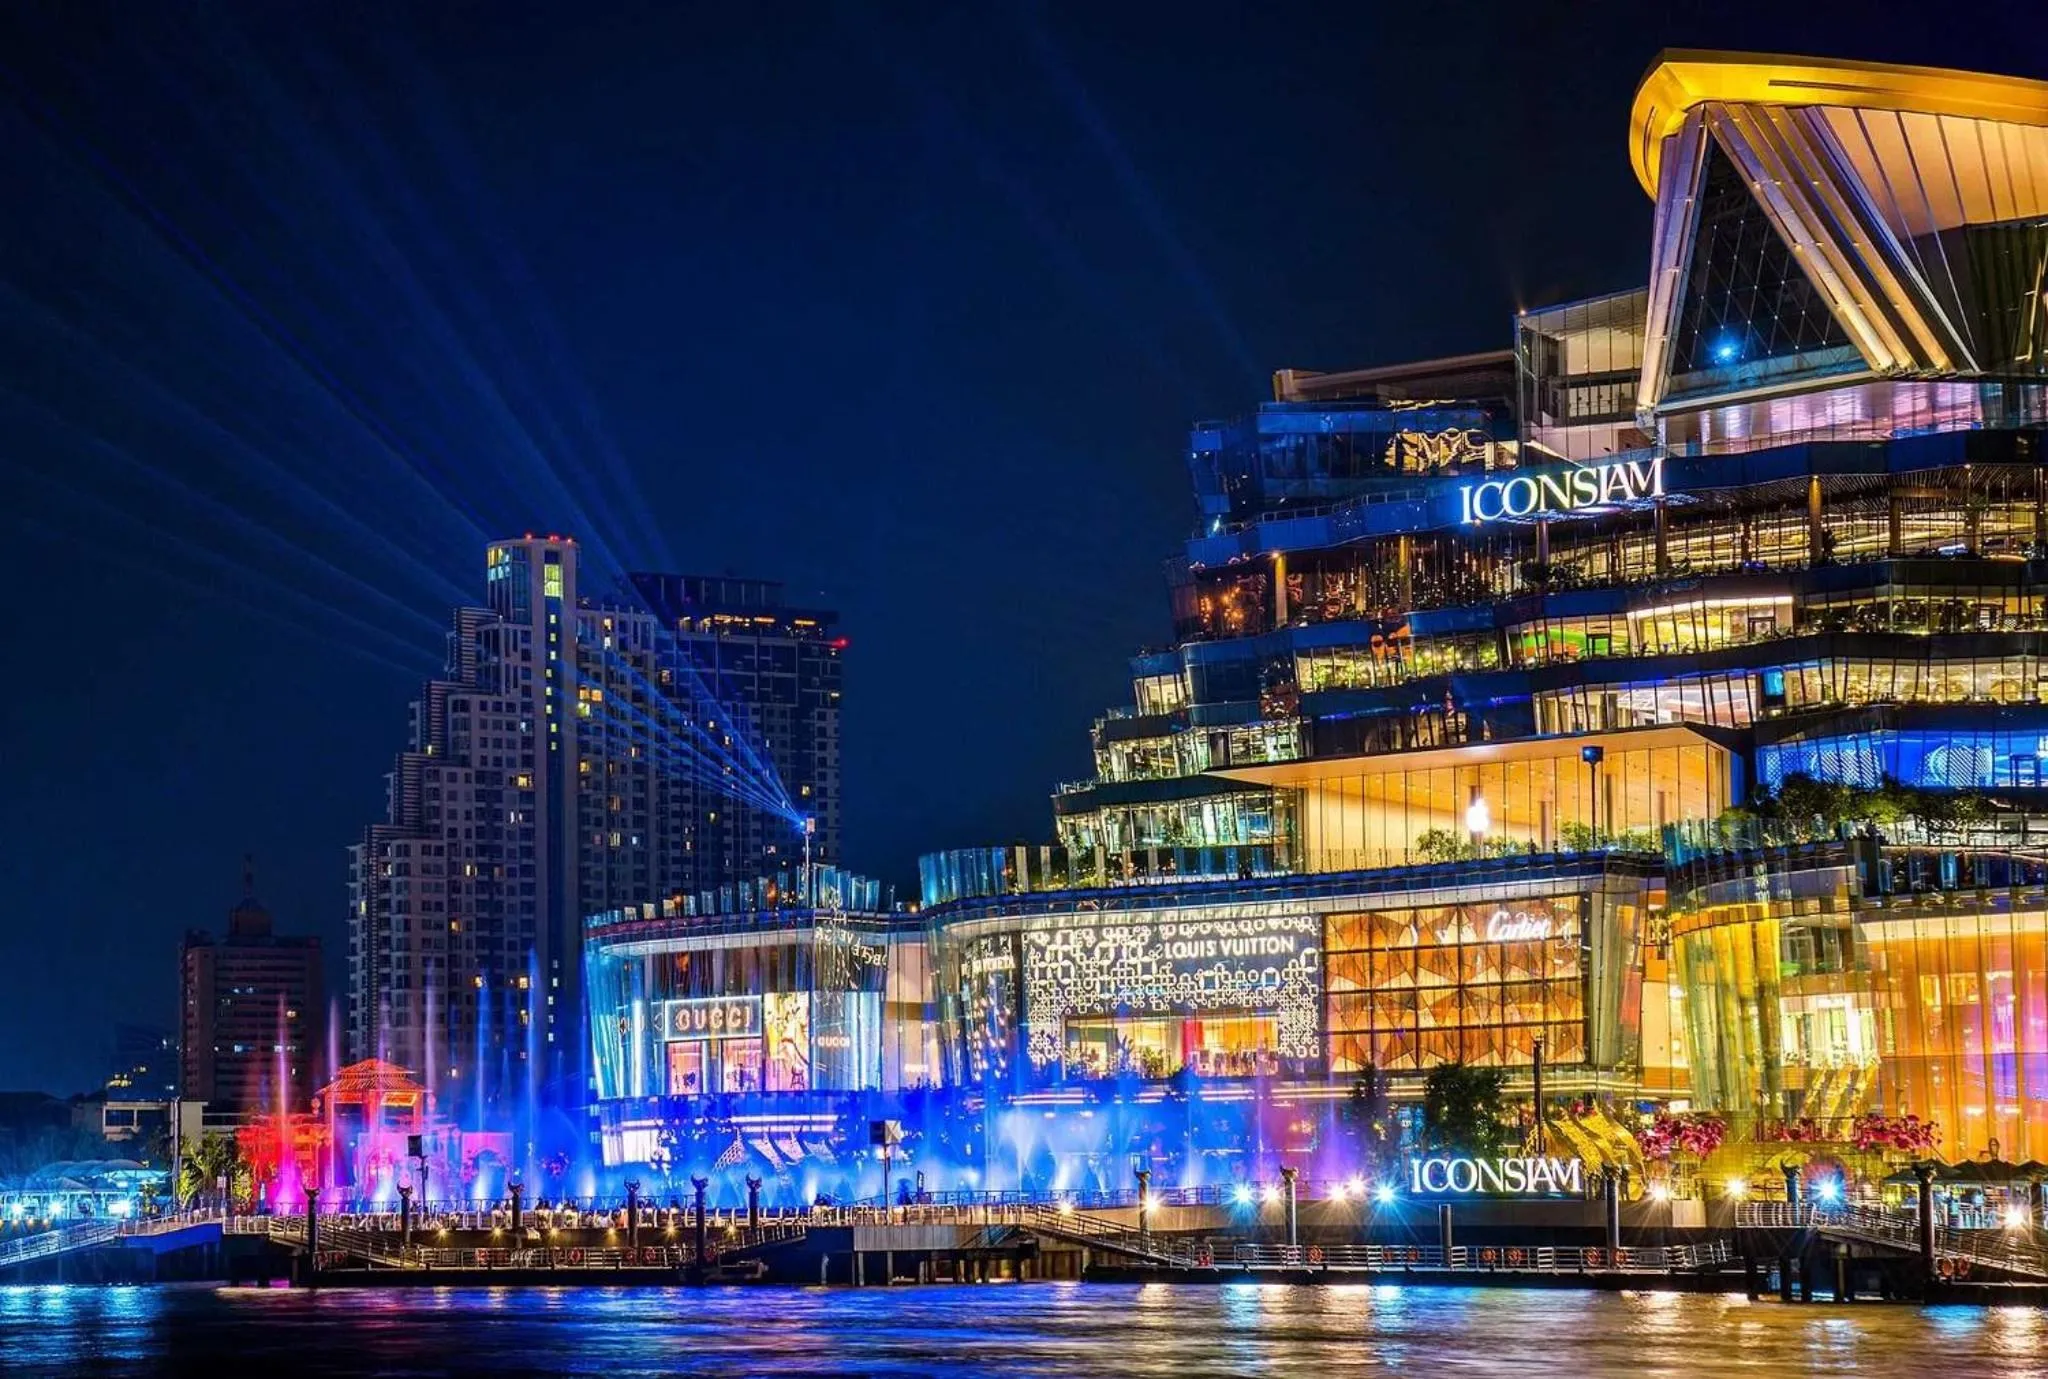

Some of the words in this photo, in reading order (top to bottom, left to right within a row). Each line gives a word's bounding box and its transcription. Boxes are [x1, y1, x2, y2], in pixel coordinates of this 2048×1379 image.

[1459, 457, 1666, 525] ICONSIAM
[1164, 939, 1218, 959] LOUIS
[1219, 935, 1295, 957] VUITTON
[675, 1005, 752, 1032] GUCCI
[1411, 1157, 1584, 1194] ICONSIAM
